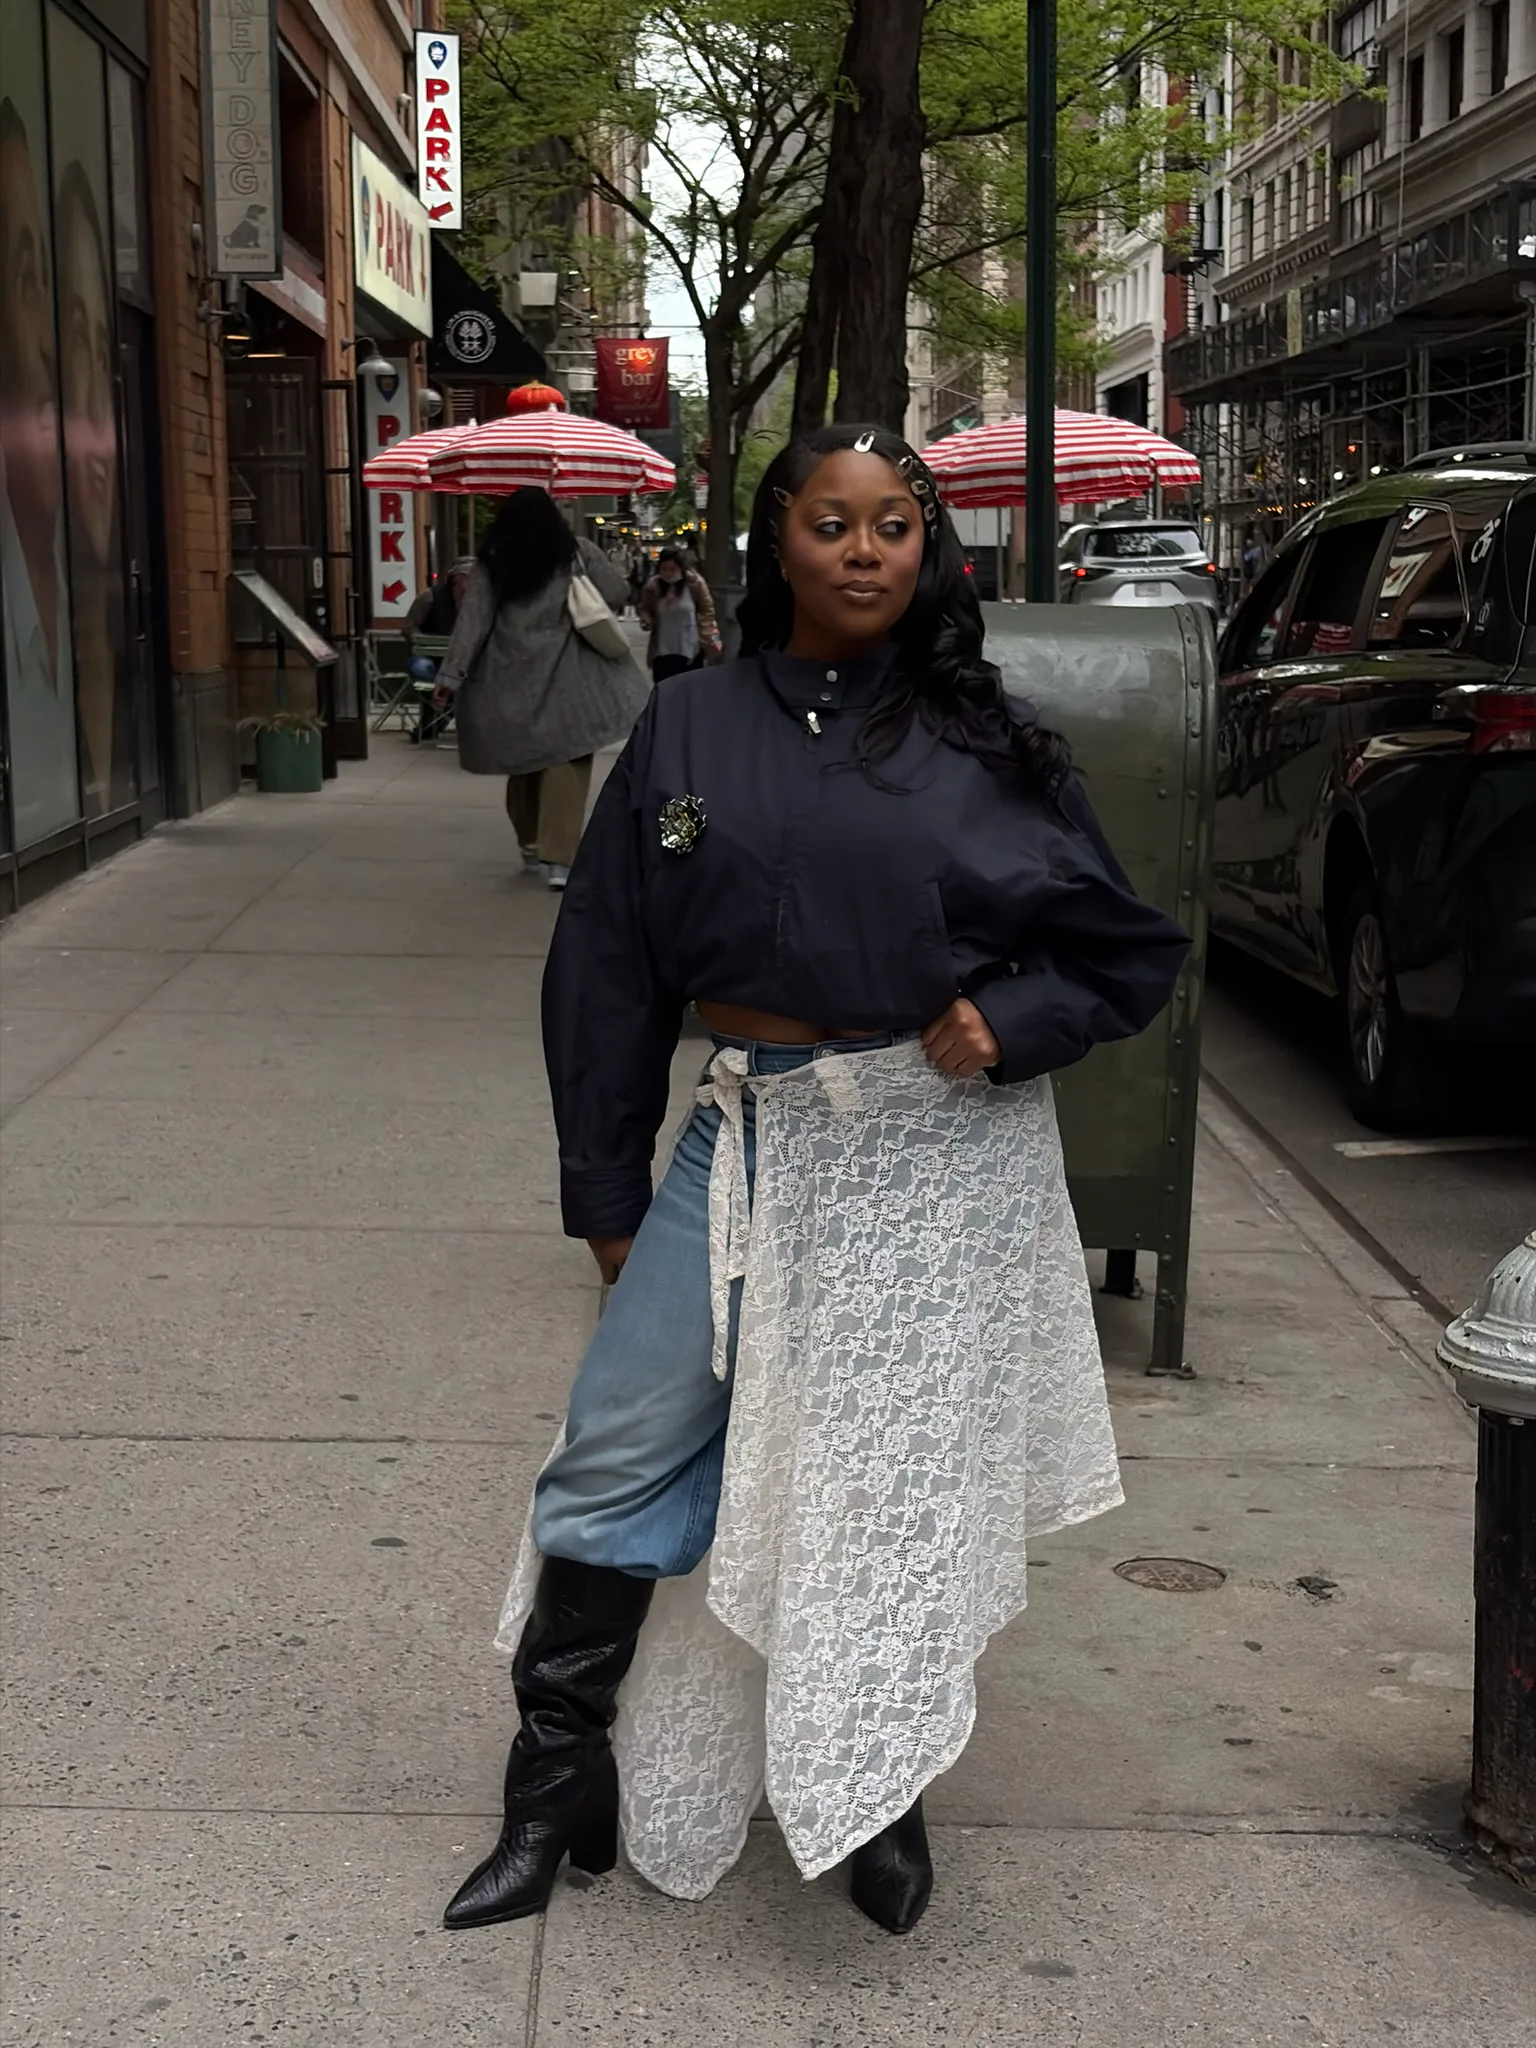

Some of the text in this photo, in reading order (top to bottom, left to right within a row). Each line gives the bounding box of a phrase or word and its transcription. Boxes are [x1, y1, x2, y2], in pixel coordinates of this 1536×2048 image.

[226, 94, 259, 196] DOG
[424, 78, 454, 192] PARK
[375, 189, 415, 298] PARK
[615, 347, 660, 366] grey
[621, 369, 655, 387] bar
[377, 414, 407, 563] PRK
